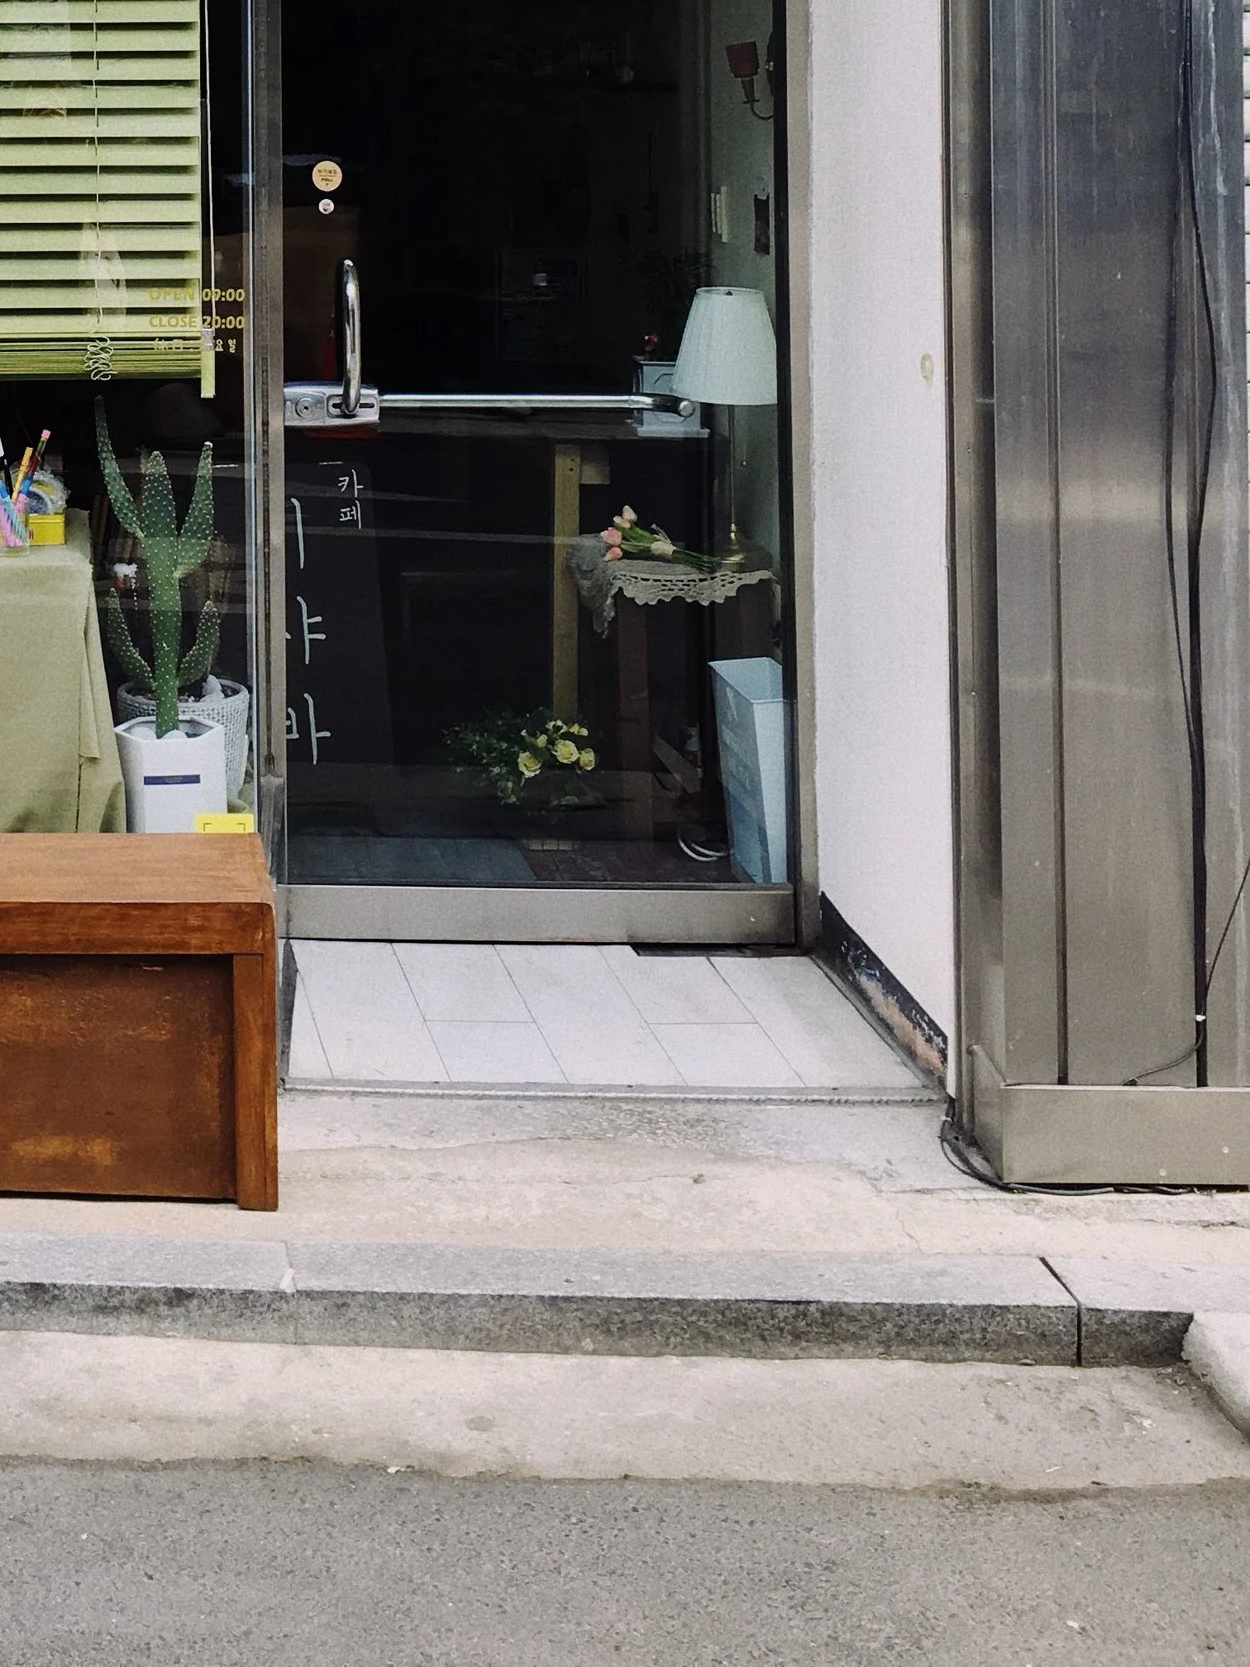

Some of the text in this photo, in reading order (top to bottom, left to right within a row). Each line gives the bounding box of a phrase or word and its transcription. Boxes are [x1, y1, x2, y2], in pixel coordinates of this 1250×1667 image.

[150, 287, 245, 301] OPEN 09:00
[149, 316, 245, 329] CLOSE 20:00
[337, 468, 365, 530] 카페
